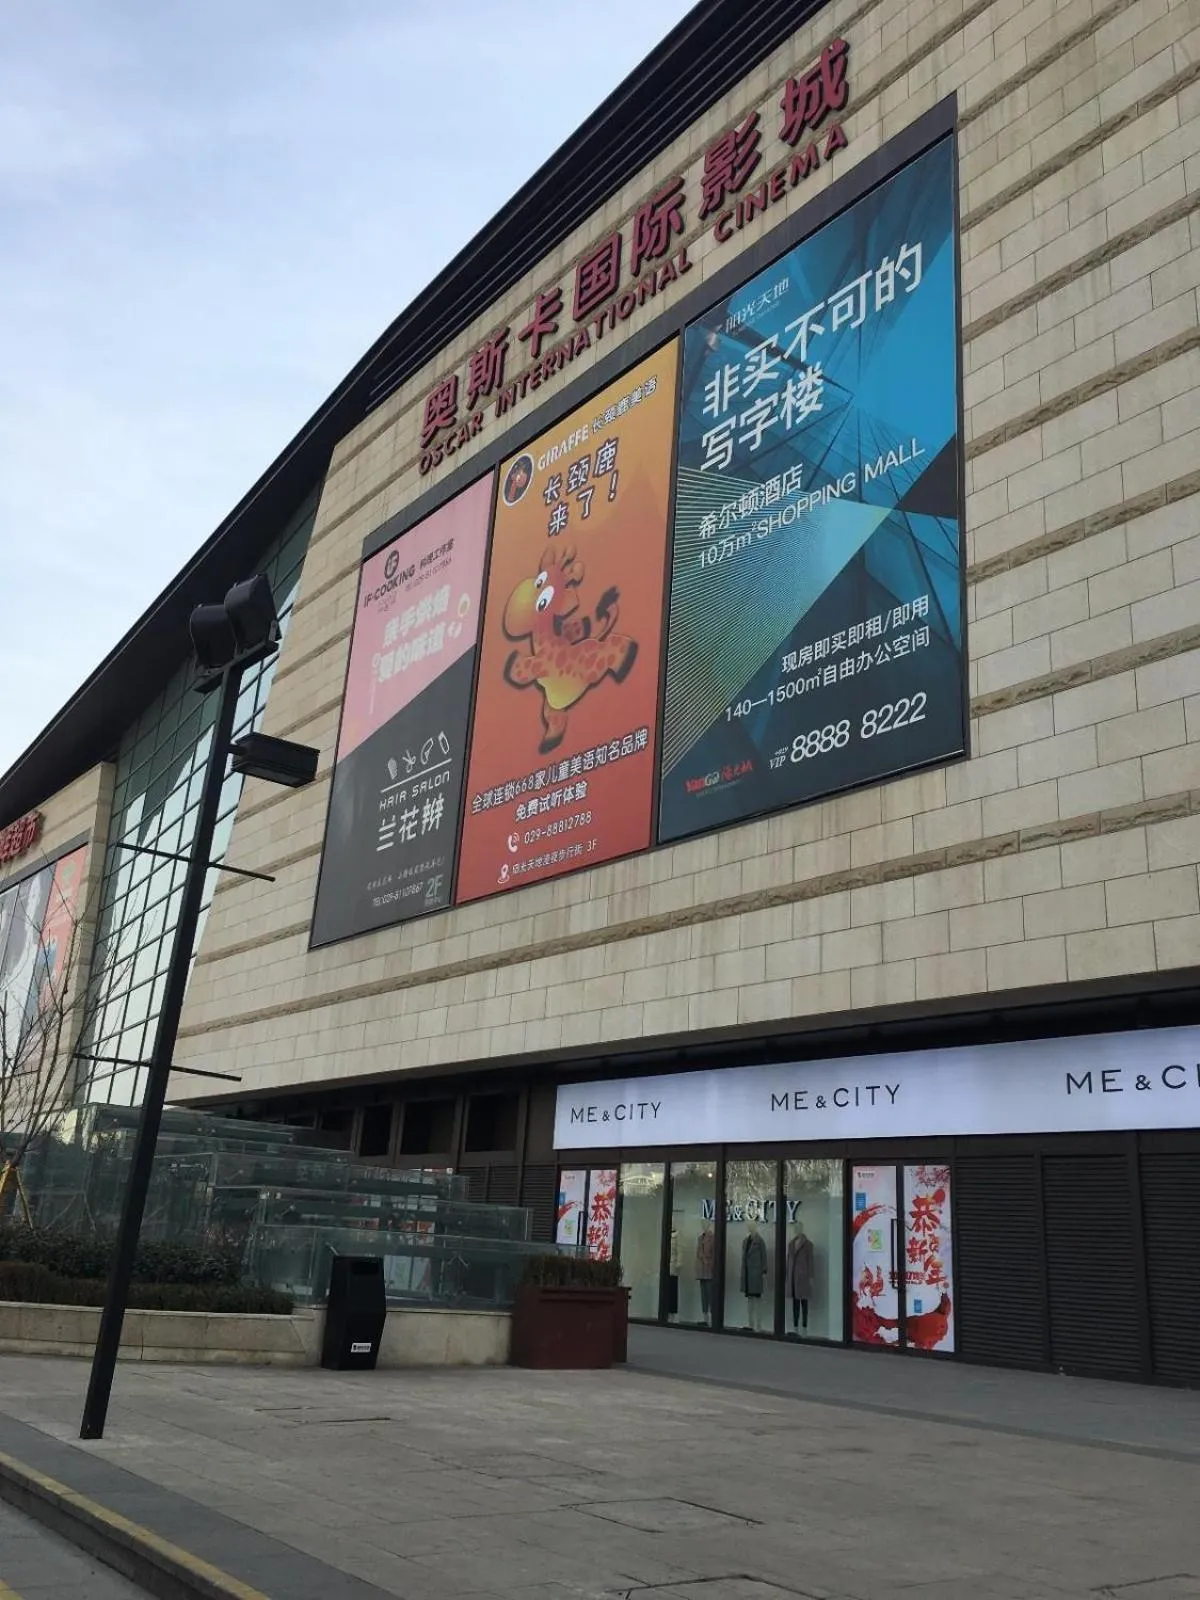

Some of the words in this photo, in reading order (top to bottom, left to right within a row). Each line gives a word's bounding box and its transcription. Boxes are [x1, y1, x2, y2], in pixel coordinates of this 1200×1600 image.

[420, 38, 850, 449] 奥斯卡国际影城
[418, 411, 484, 477] OSCAR
[493, 251, 693, 418] INTERNATIONAL
[713, 123, 849, 244] CINEMA
[702, 241, 923, 418] 非买不可的
[537, 424, 589, 471] GIRAFFE
[700, 361, 823, 471] 写字楼
[544, 438, 619, 506] 长颈鹿
[863, 437, 926, 482] MALL
[698, 463, 804, 540] 希尔顿酒店
[781, 594, 929, 674] 现房即买即租/即用
[769, 755, 786, 769] VIP
[790, 719, 850, 763] 8888
[860, 692, 927, 739] 8222
[515, 781, 588, 822] 免费试听体验
[426, 874, 443, 897] 2F
